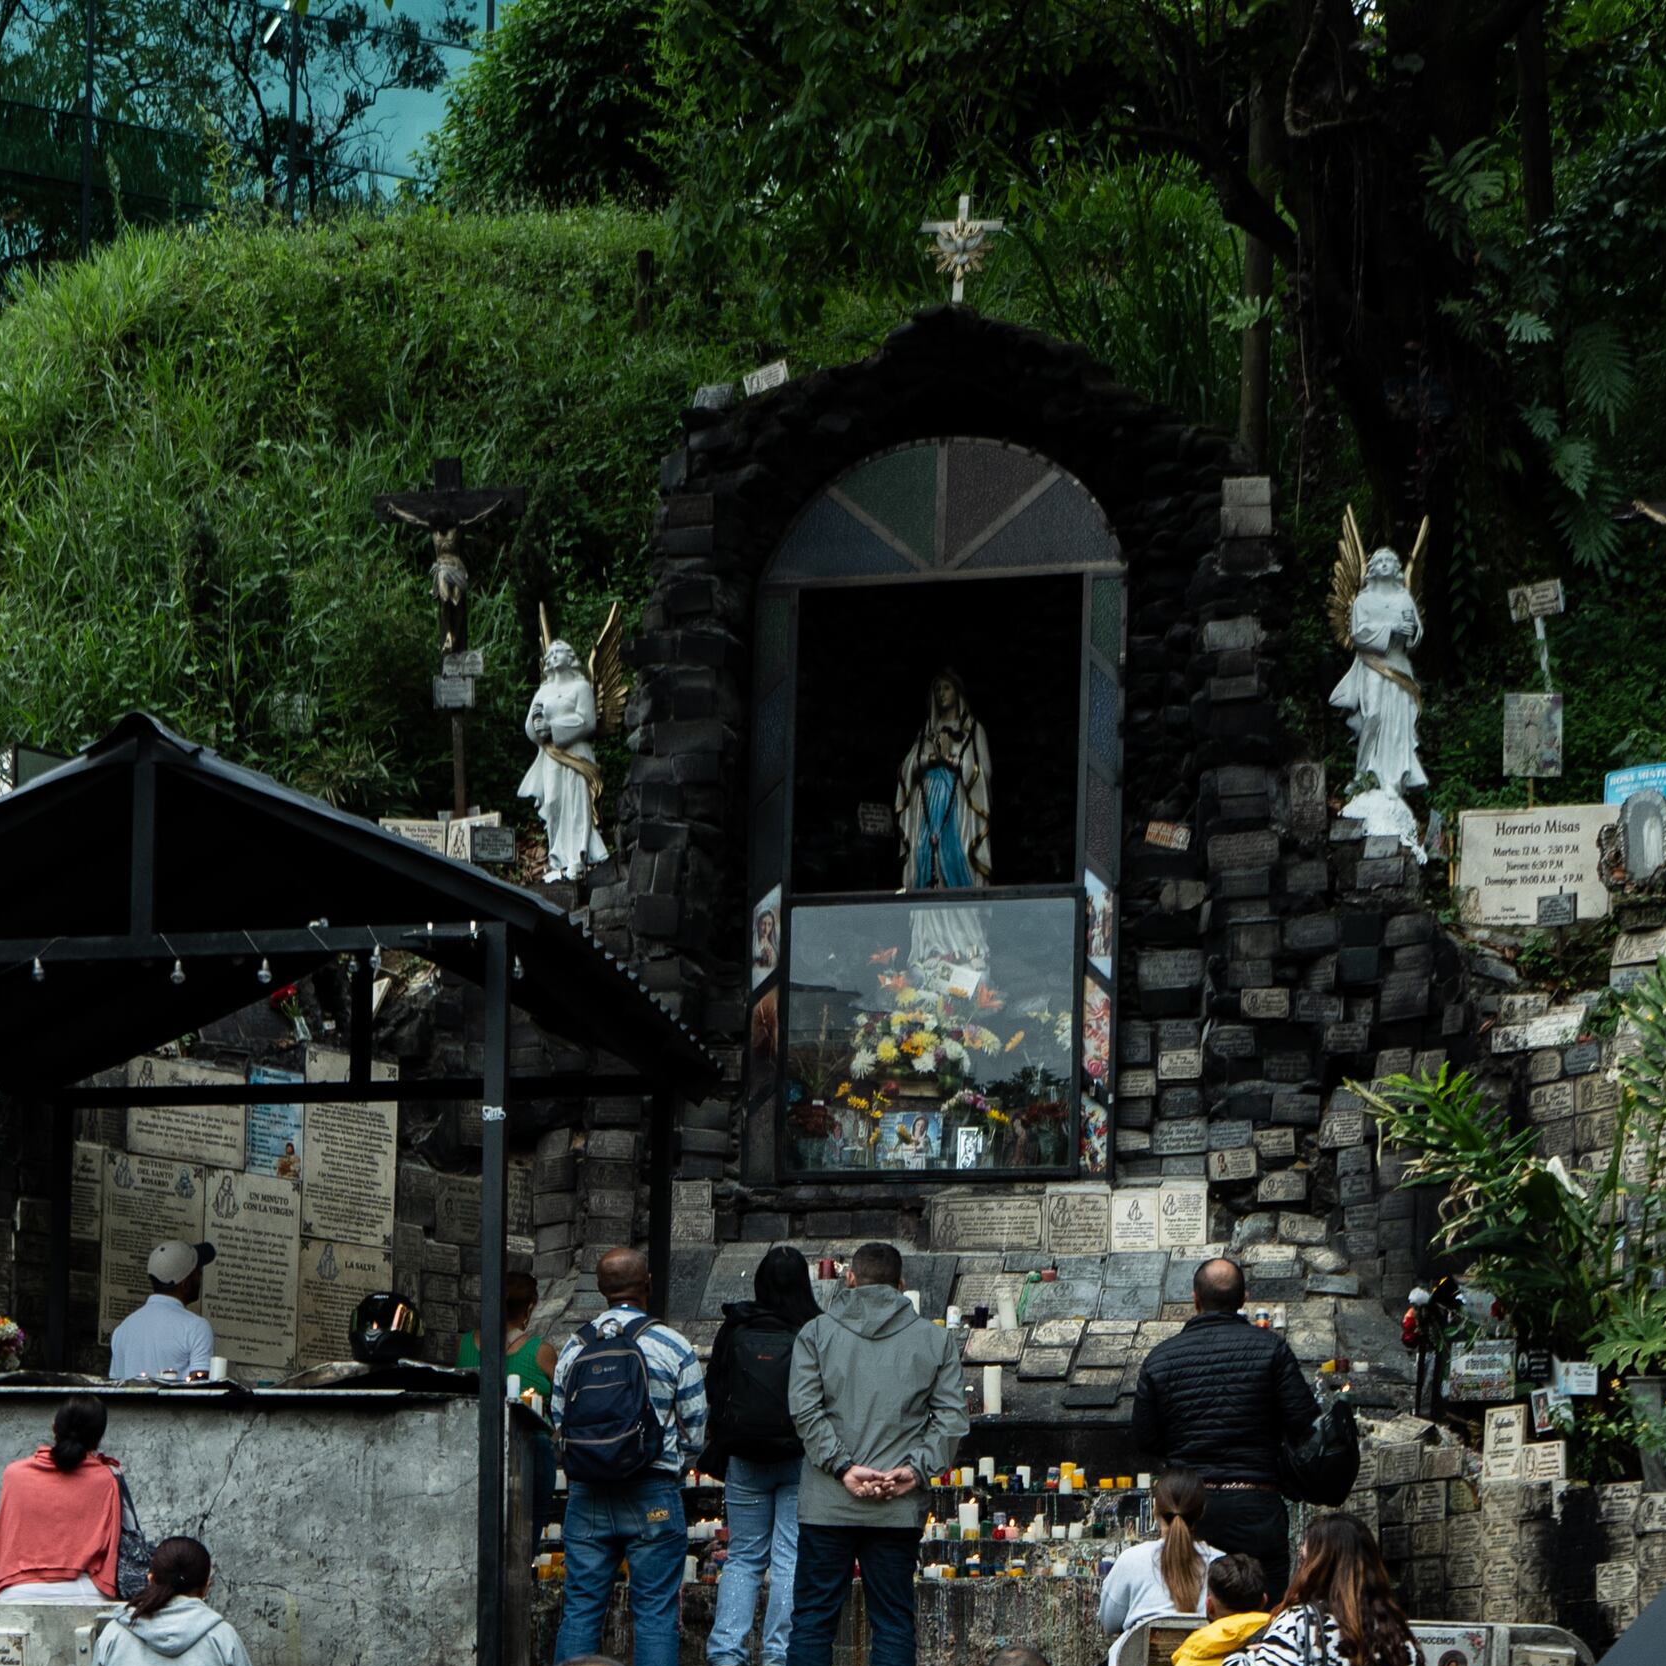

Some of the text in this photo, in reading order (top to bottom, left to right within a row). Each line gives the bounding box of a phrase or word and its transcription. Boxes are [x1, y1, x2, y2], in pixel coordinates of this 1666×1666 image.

[1496, 821, 1580, 836] Horario Misas
[250, 1192, 289, 1205] UN MINUTO
[243, 1202, 294, 1217] CON LA VIRGEN
[344, 1261, 377, 1273] LA SALVE
